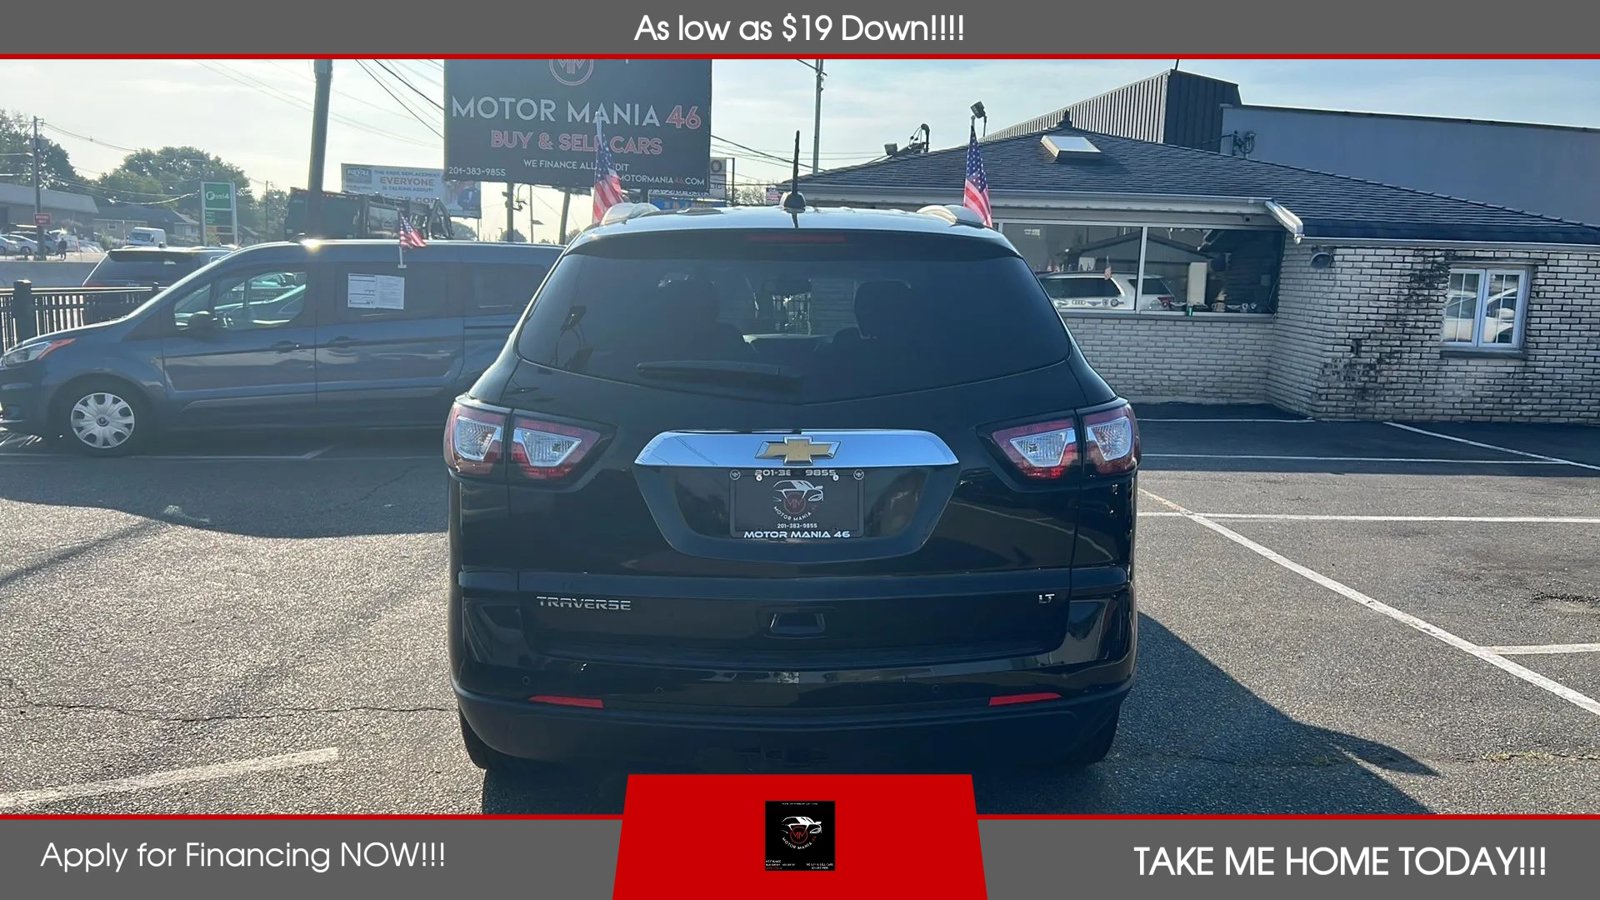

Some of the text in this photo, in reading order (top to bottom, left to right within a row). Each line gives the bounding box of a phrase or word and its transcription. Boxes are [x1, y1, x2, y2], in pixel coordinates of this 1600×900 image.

[452, 96, 702, 130] MOTOR MANIA 46
[490, 130, 534, 149] BUY
[538, 131, 554, 150] &
[610, 135, 663, 155] CARS
[523, 159, 538, 168] WE
[539, 160, 577, 170] FINANCE
[579, 161, 597, 171] ALL
[448, 166, 506, 177] 201-383-9855
[380, 176, 435, 187] EVERYONE
[773, 506, 812, 521] MOTOR MANIA
[743, 530, 851, 539] MOTOR MANIA 46
[536, 596, 632, 611] TRAVERSE
[1038, 593, 1055, 604] LT
